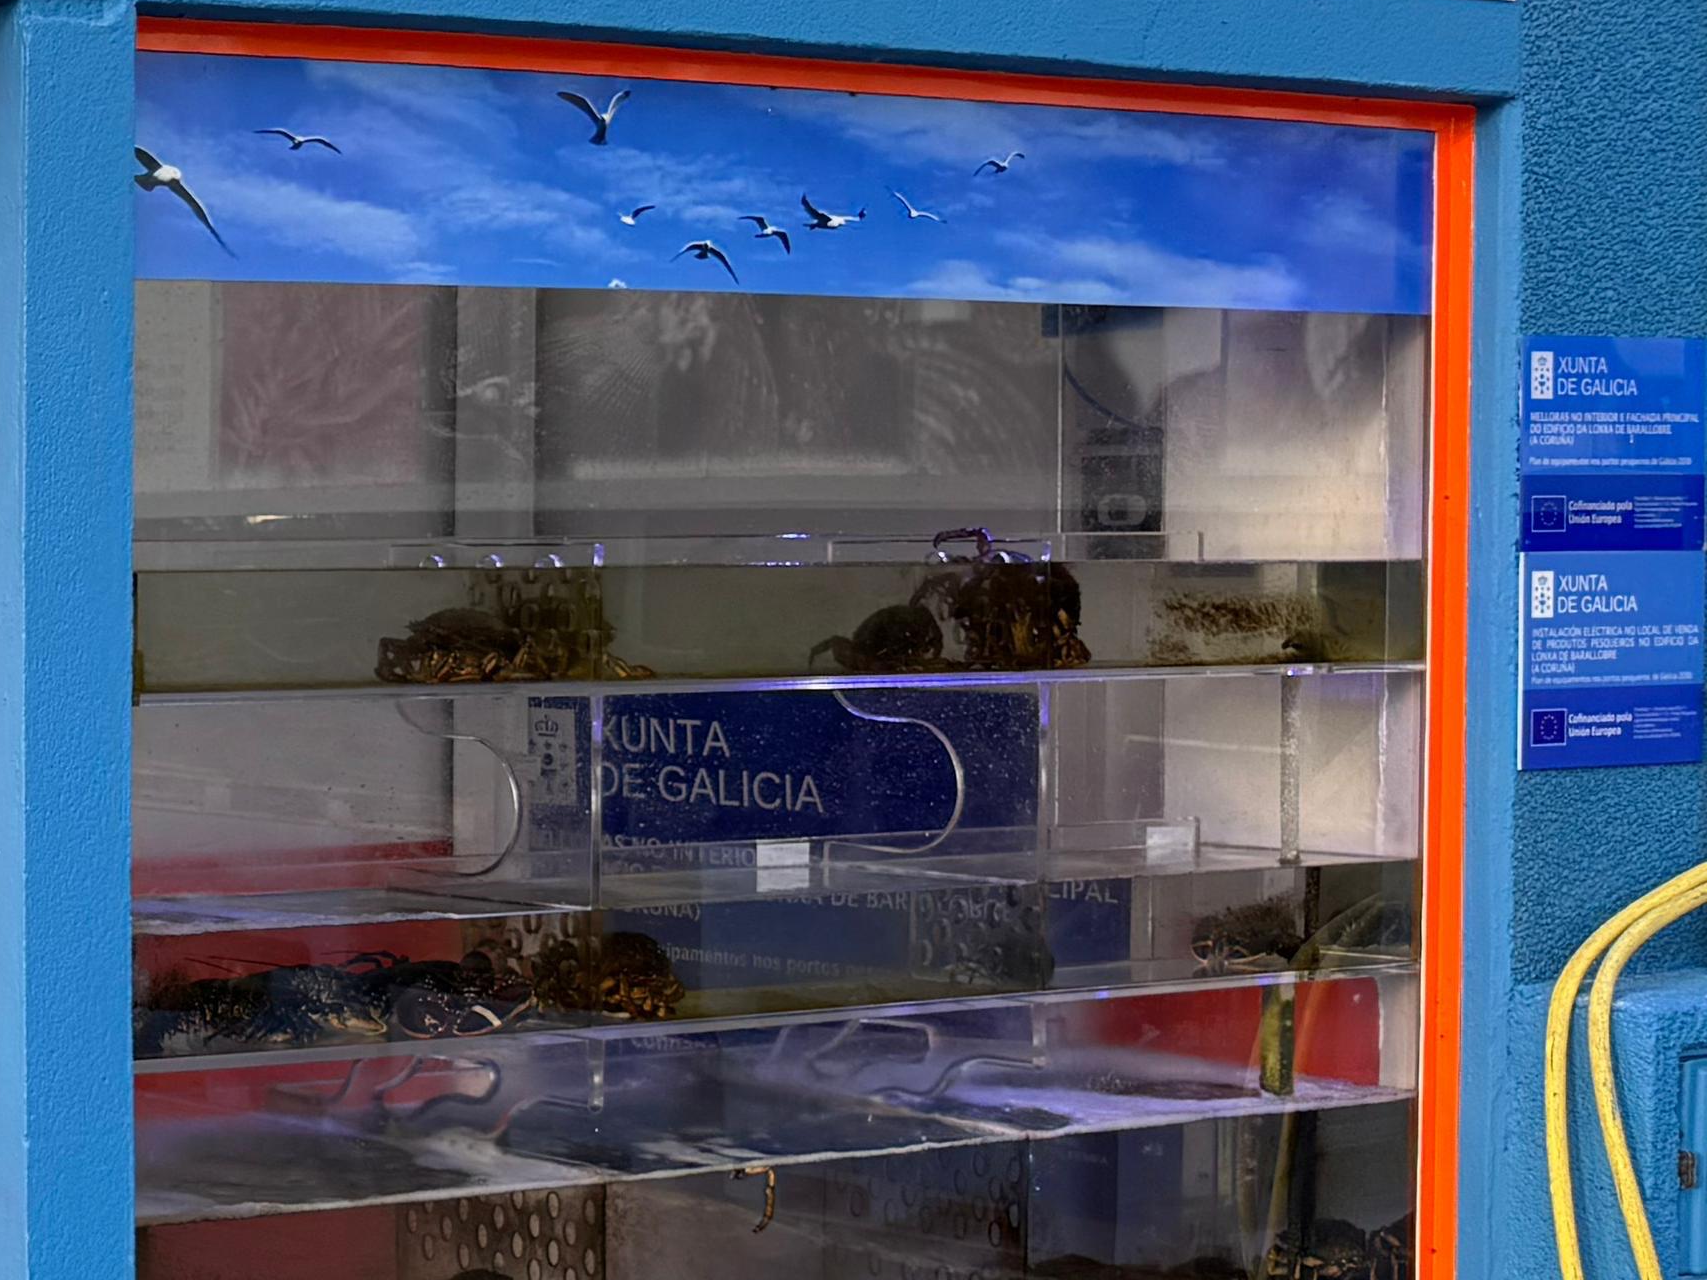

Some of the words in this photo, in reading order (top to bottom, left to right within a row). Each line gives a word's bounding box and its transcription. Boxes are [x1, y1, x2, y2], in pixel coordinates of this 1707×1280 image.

[1558, 356, 1608, 374] XUNTA
[1557, 378, 1578, 395] DE
[1581, 378, 1637, 396] GALICIA
[1558, 575, 1608, 592] XUNTA
[1557, 596, 1578, 613] DE
[1581, 595, 1637, 612] GALICIA
[658, 765, 824, 814] GALICIA
[670, 839, 757, 867] INTERIO
